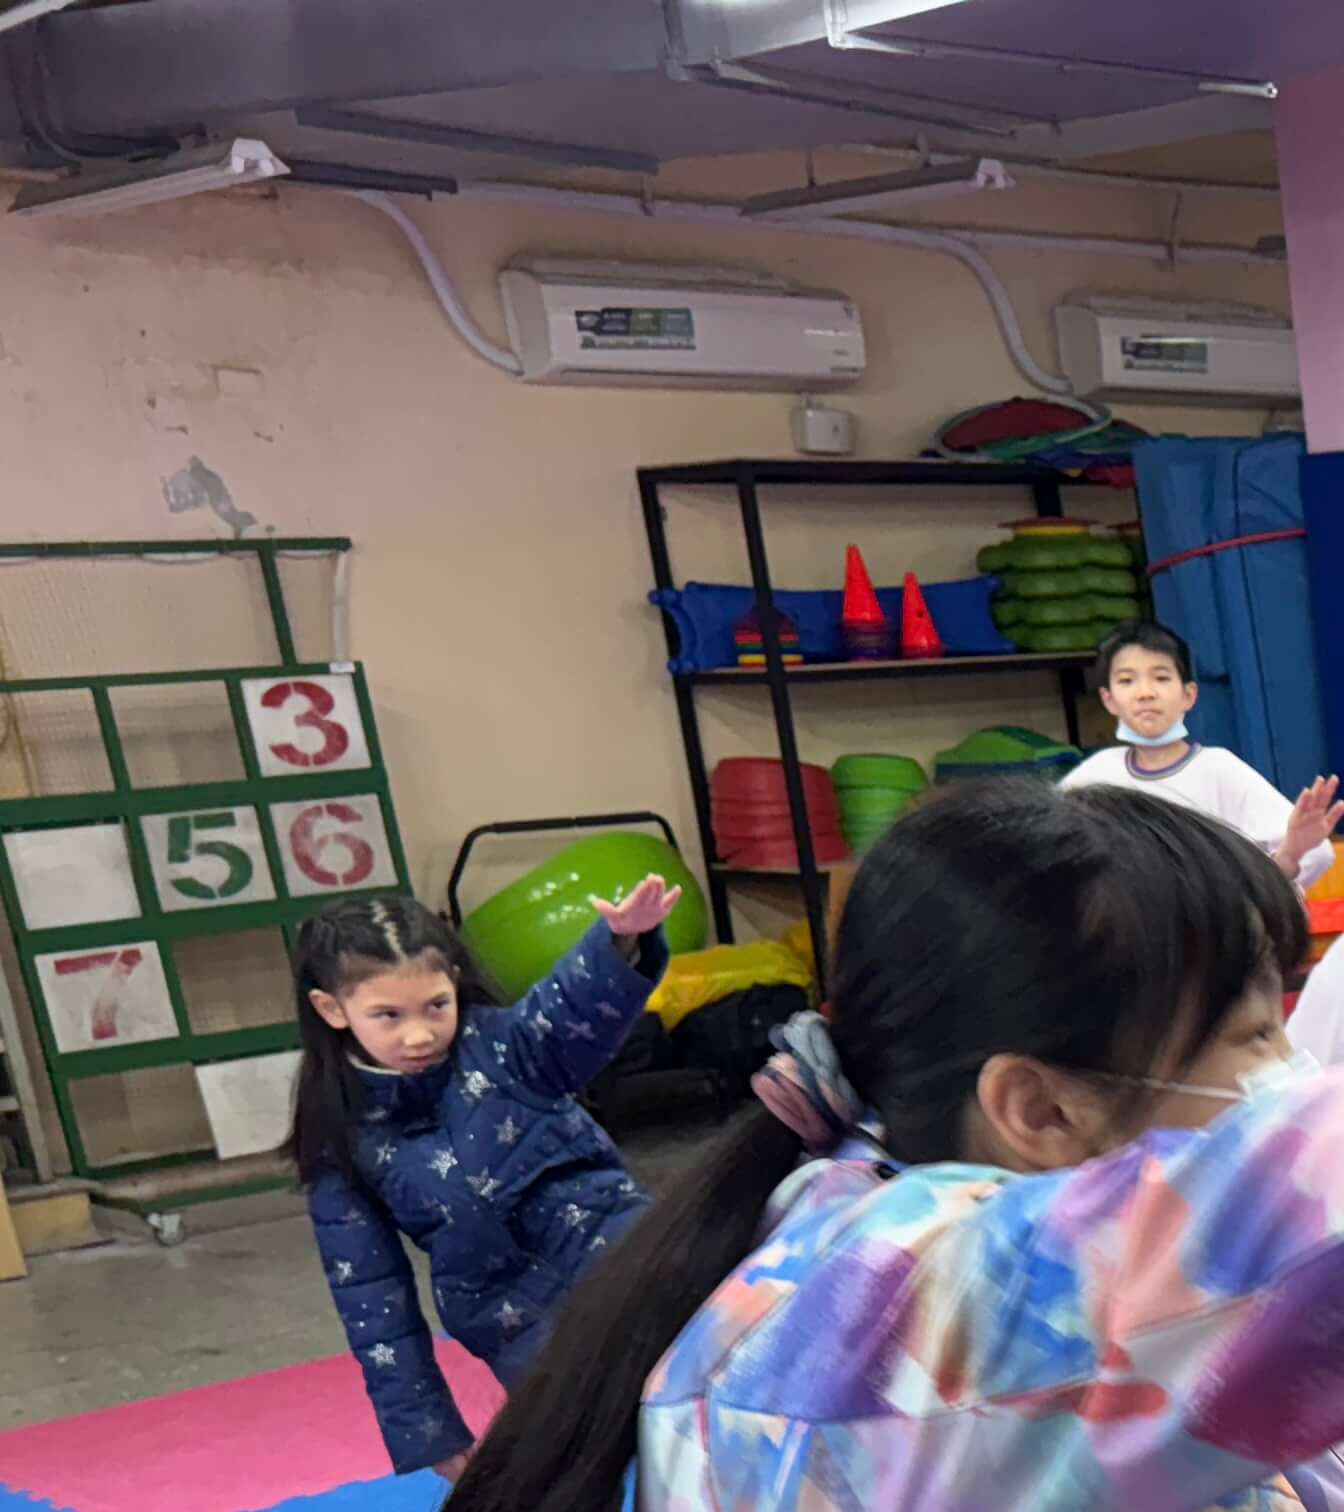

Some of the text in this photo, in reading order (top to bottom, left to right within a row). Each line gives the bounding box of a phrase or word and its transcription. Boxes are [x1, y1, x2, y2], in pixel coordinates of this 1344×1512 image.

[259, 681, 349, 767] 3
[167, 803, 375, 899] 5 6
[53, 948, 143, 1041] 7
